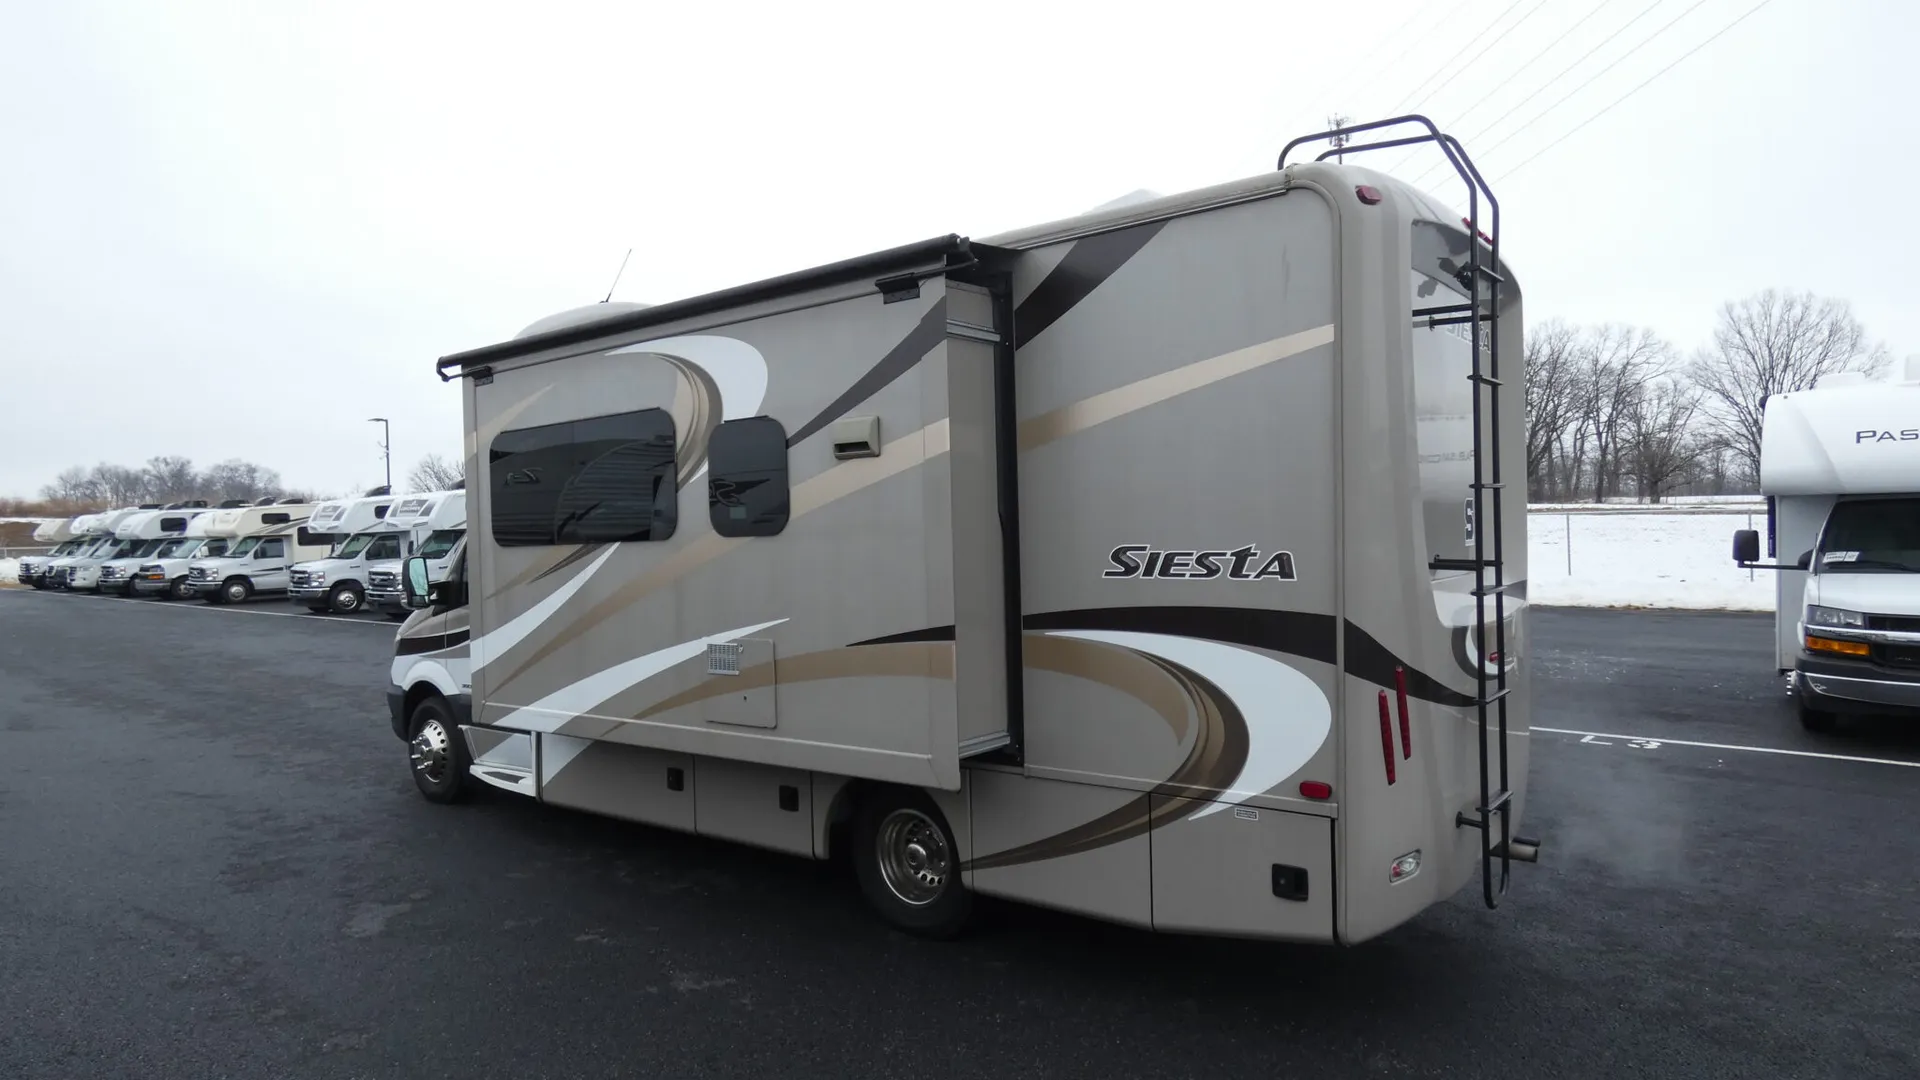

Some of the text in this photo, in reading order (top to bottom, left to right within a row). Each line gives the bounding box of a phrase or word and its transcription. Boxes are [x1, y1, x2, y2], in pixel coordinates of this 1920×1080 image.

[1445, 321, 1492, 354] SIEA
[1855, 428, 1919, 444] PAS
[1102, 543, 1298, 582] SIESTA
